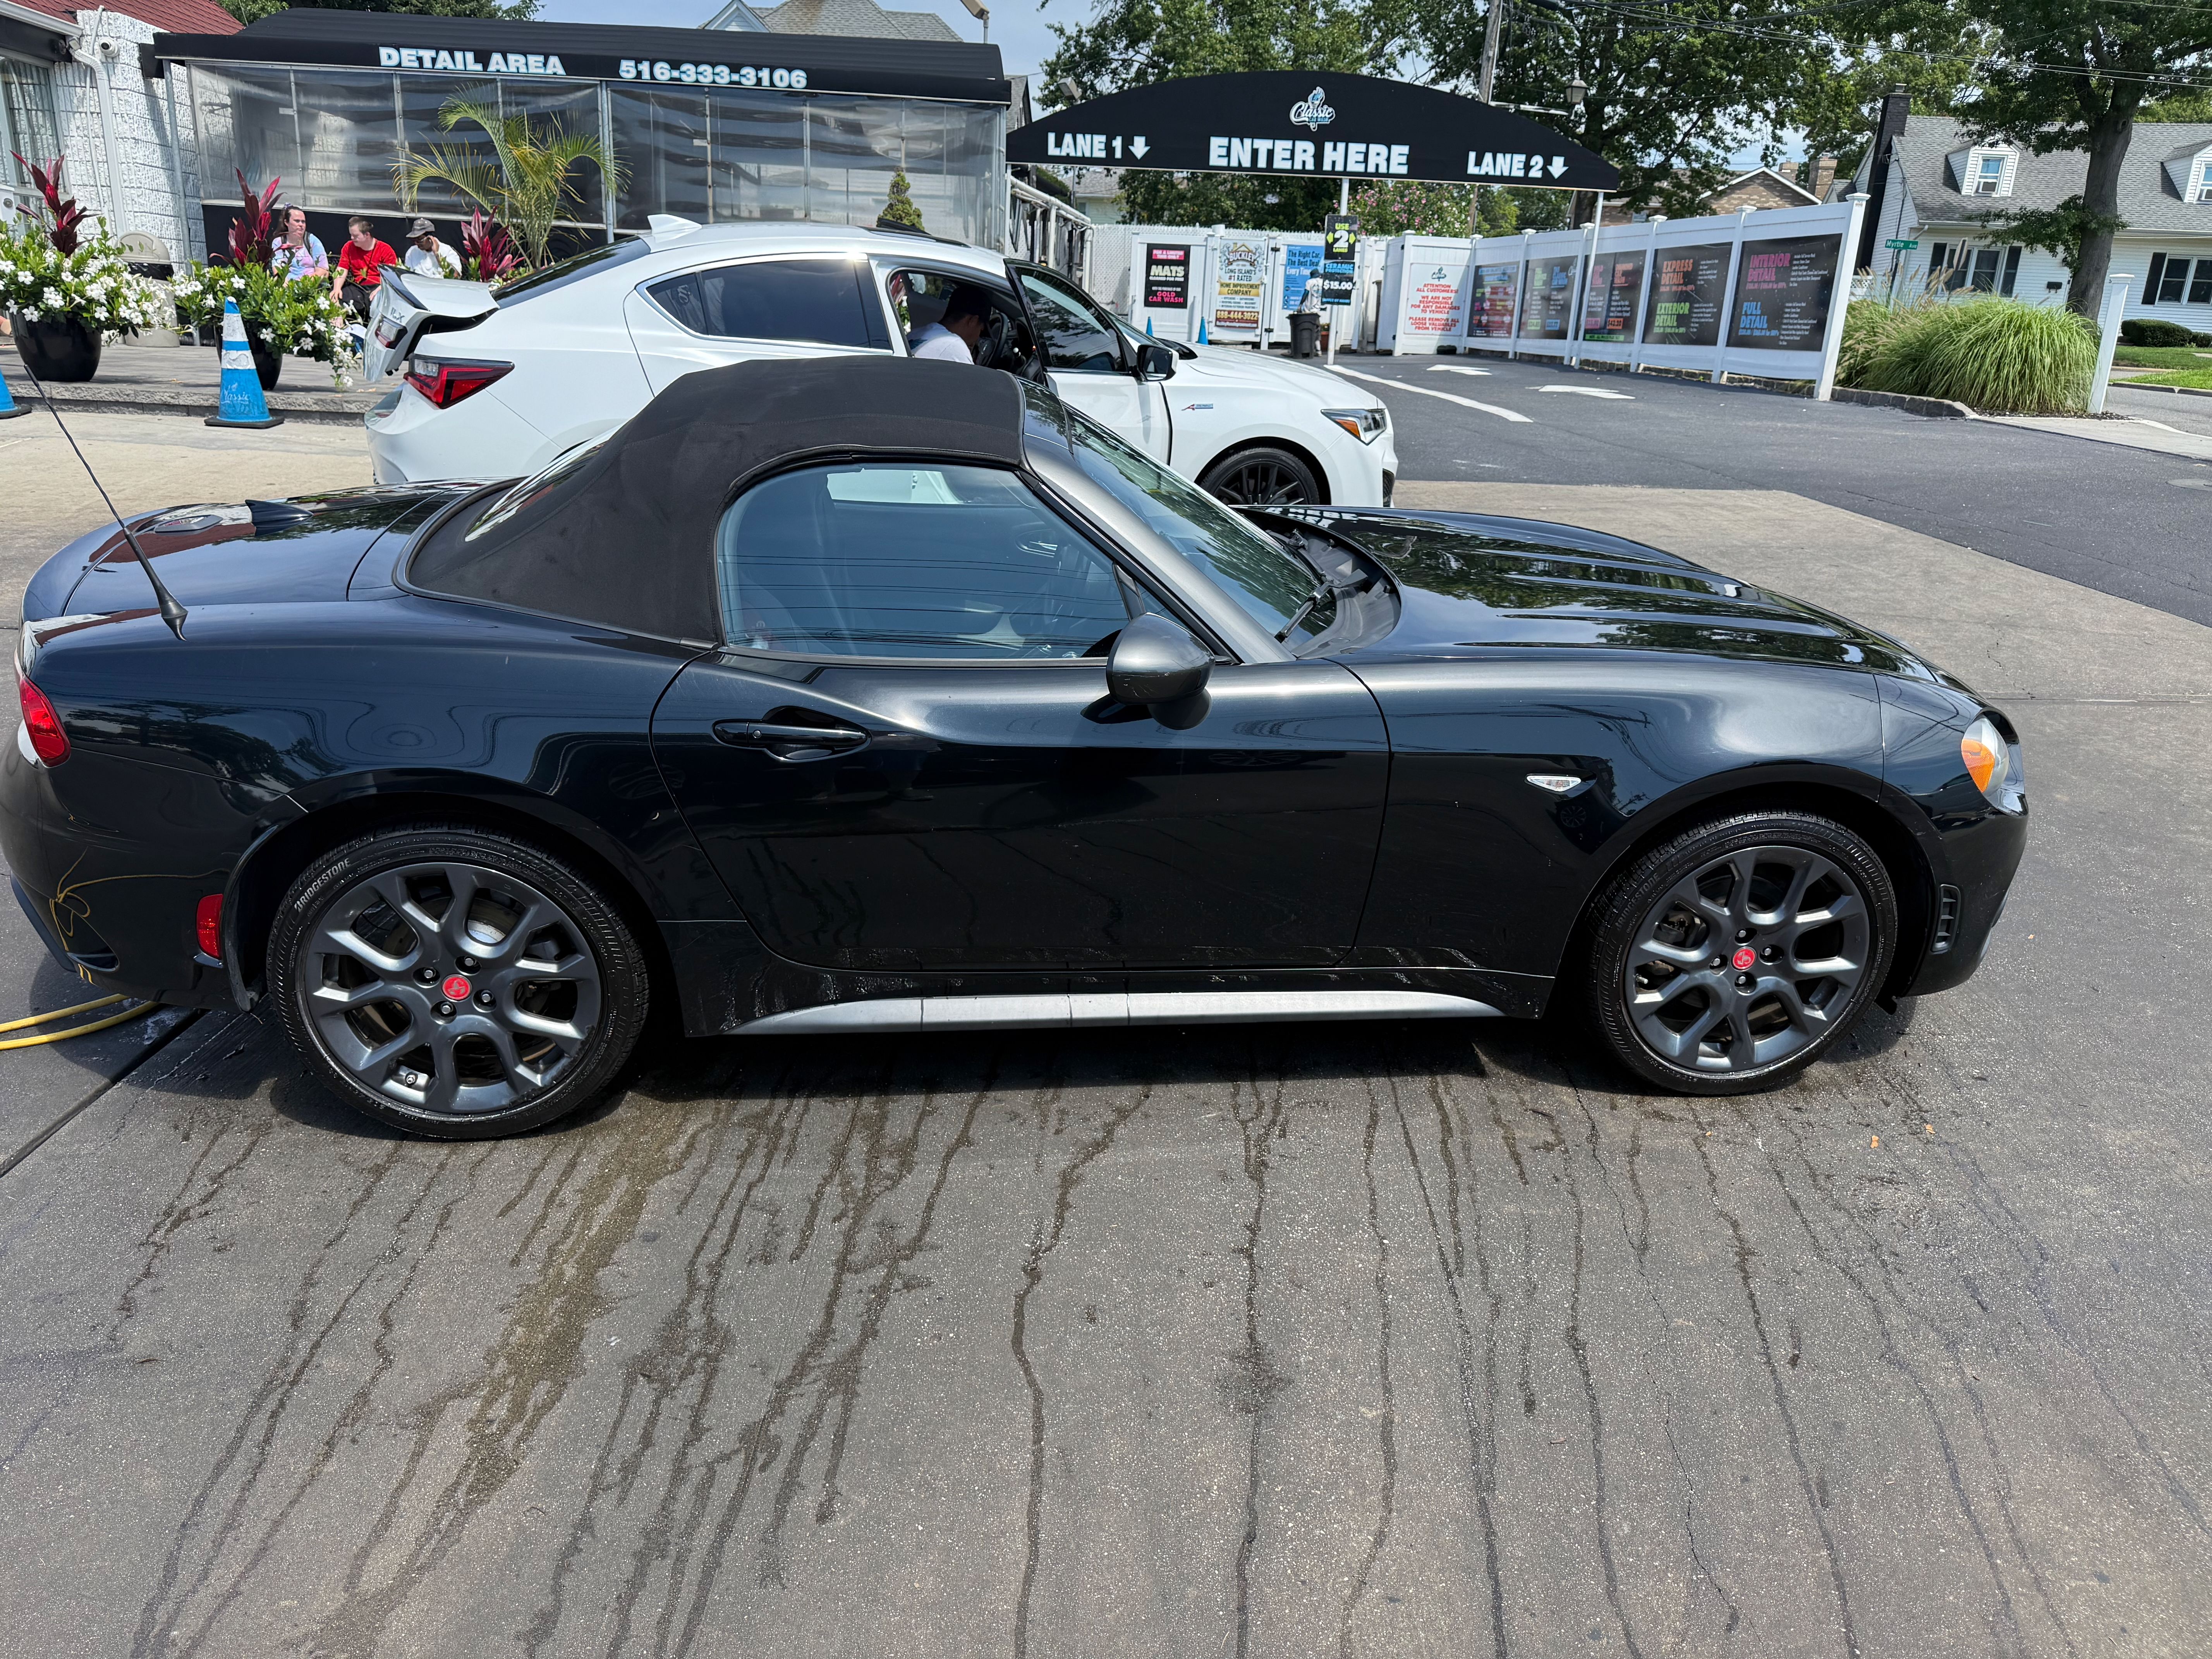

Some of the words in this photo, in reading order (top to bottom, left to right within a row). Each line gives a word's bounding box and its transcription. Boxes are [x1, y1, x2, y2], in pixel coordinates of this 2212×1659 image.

[379, 46, 483, 71] DETAIL
[487, 52, 566, 75] AREA
[619, 59, 807, 89] 516-333-3106
[1291, 102, 1333, 122] Classic
[1048, 132, 1106, 158] LANE
[1112, 136, 1122, 159] 1
[1209, 136, 1316, 170] ENTER
[1322, 141, 1410, 174] HERE
[1467, 151, 1526, 177] LANE
[1528, 155, 1544, 178] 2
[1333, 230, 1349, 248] 2
[1886, 240, 1904, 248] Myrtle
[1229, 251, 1255, 263] BUCKLEY
[1288, 250, 1297, 258] The
[1298, 250, 1310, 259] Right
[1749, 253, 1791, 268] INTERIOR
[1150, 265, 1185, 277] MATS
[1286, 266, 1300, 276] Every
[1662, 259, 1693, 273] EXPRESS
[1661, 272, 1684, 285] DETAIL
[1747, 267, 1776, 282] DETAIL
[1323, 279, 1353, 290] $15.00
[1656, 302, 1690, 314] EXTERIOR
[1742, 301, 1761, 315] FULL
[1654, 314, 1677, 326] DETAIL
[1740, 315, 1768, 328] DETAIL
[294, 858, 351, 912] BRIDGESTONE
[1614, 872, 1660, 931] BRIDGESTONE
